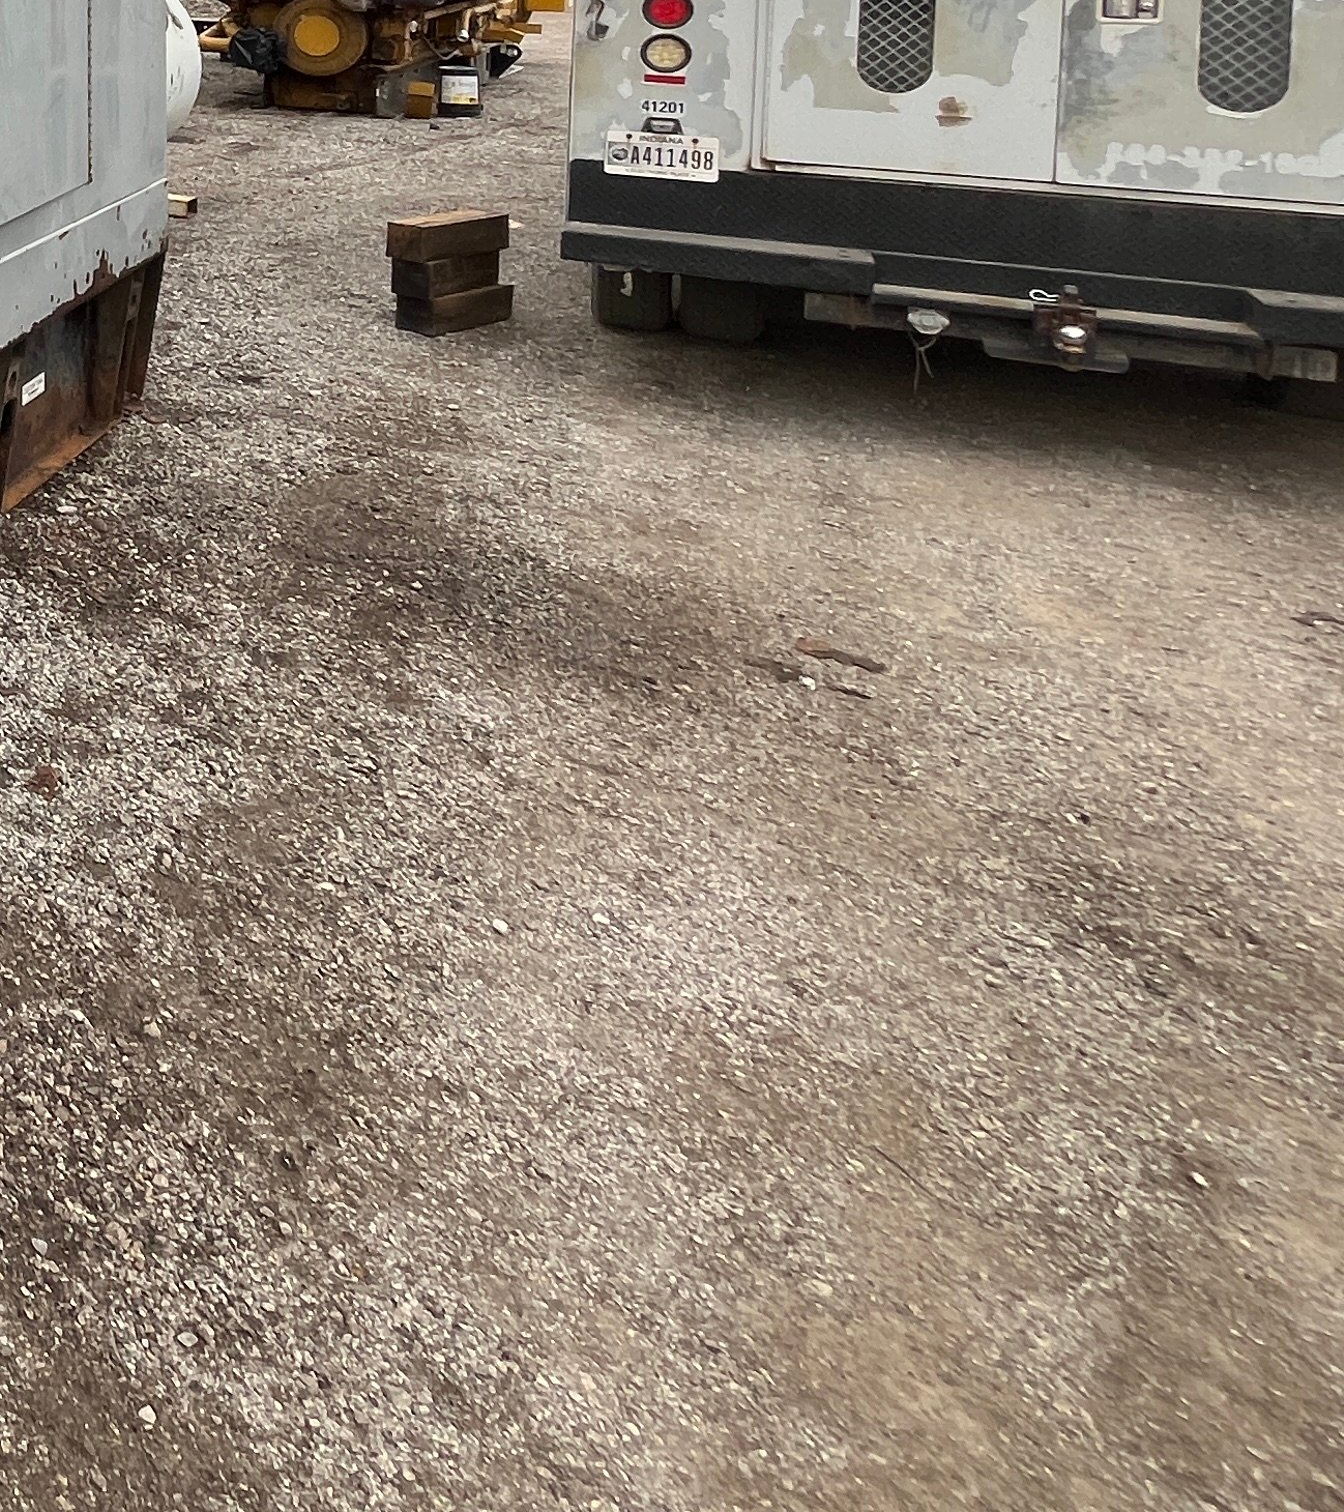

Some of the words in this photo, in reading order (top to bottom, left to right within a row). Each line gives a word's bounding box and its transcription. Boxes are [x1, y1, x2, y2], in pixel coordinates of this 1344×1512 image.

[641, 100, 684, 114] 41201
[639, 135, 684, 145] INDIANA
[631, 145, 714, 171] A411498
